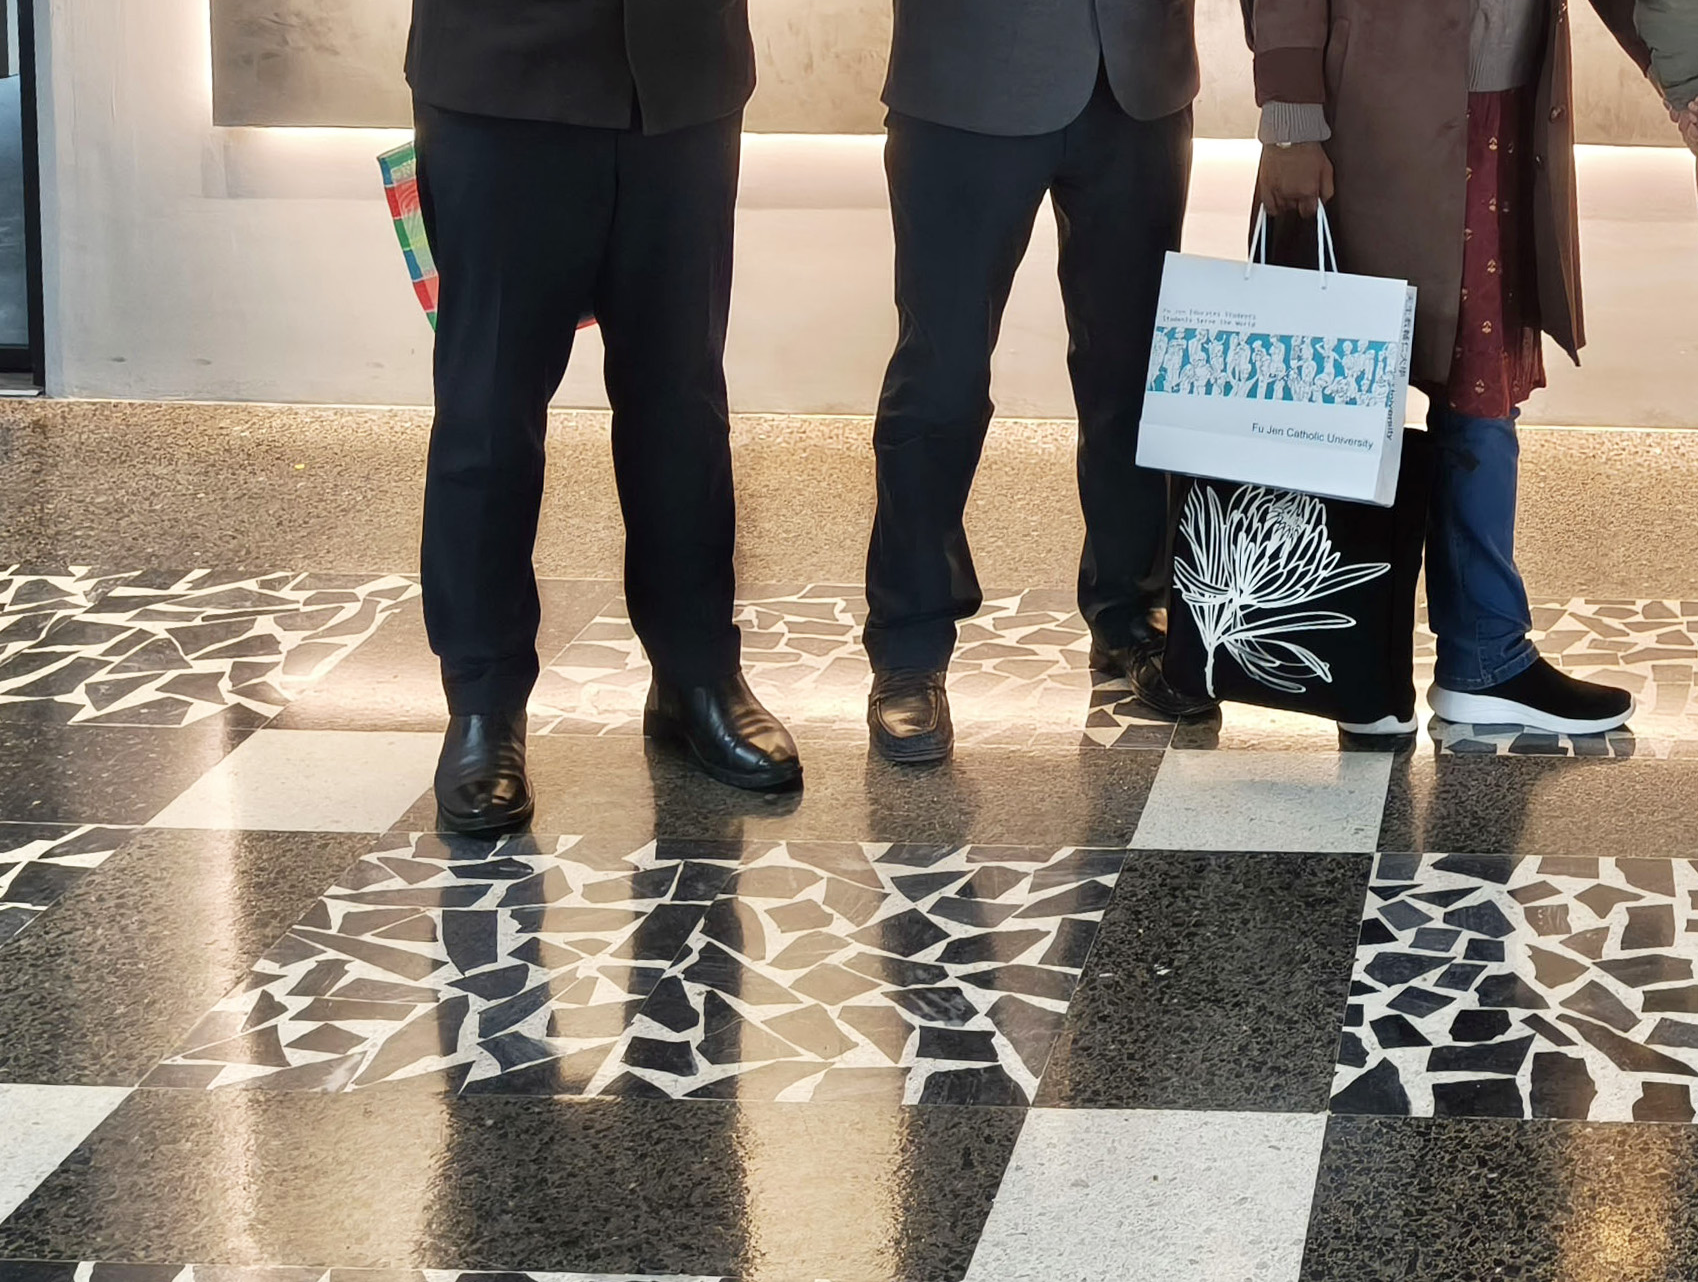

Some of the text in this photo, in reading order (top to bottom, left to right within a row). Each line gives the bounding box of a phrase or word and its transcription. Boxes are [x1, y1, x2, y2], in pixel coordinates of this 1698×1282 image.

[1252, 422, 1374, 450] Fu Jen Catholic University
